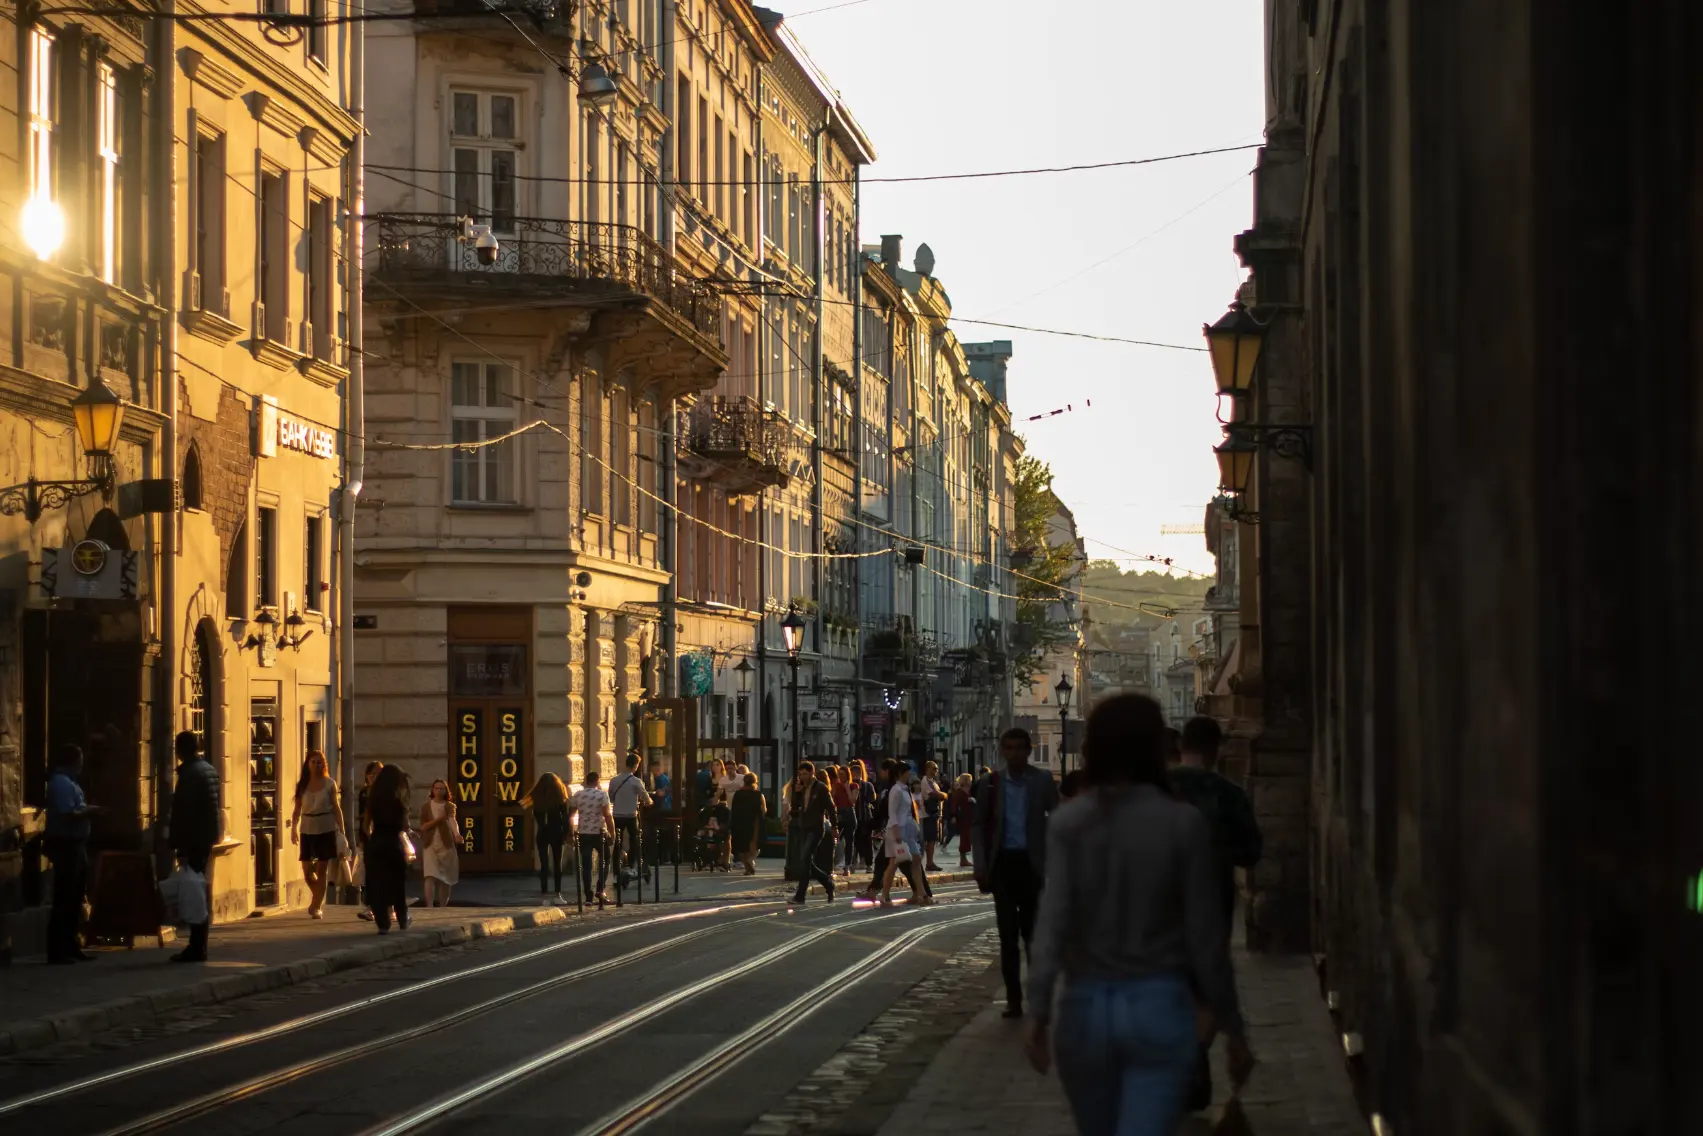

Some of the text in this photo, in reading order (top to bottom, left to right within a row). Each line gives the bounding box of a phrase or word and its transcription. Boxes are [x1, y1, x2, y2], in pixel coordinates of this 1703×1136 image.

[281, 418, 308, 451] БАНК
[458, 713, 480, 852] SHOW BAR
[498, 713, 520, 851] SHOW BAR
